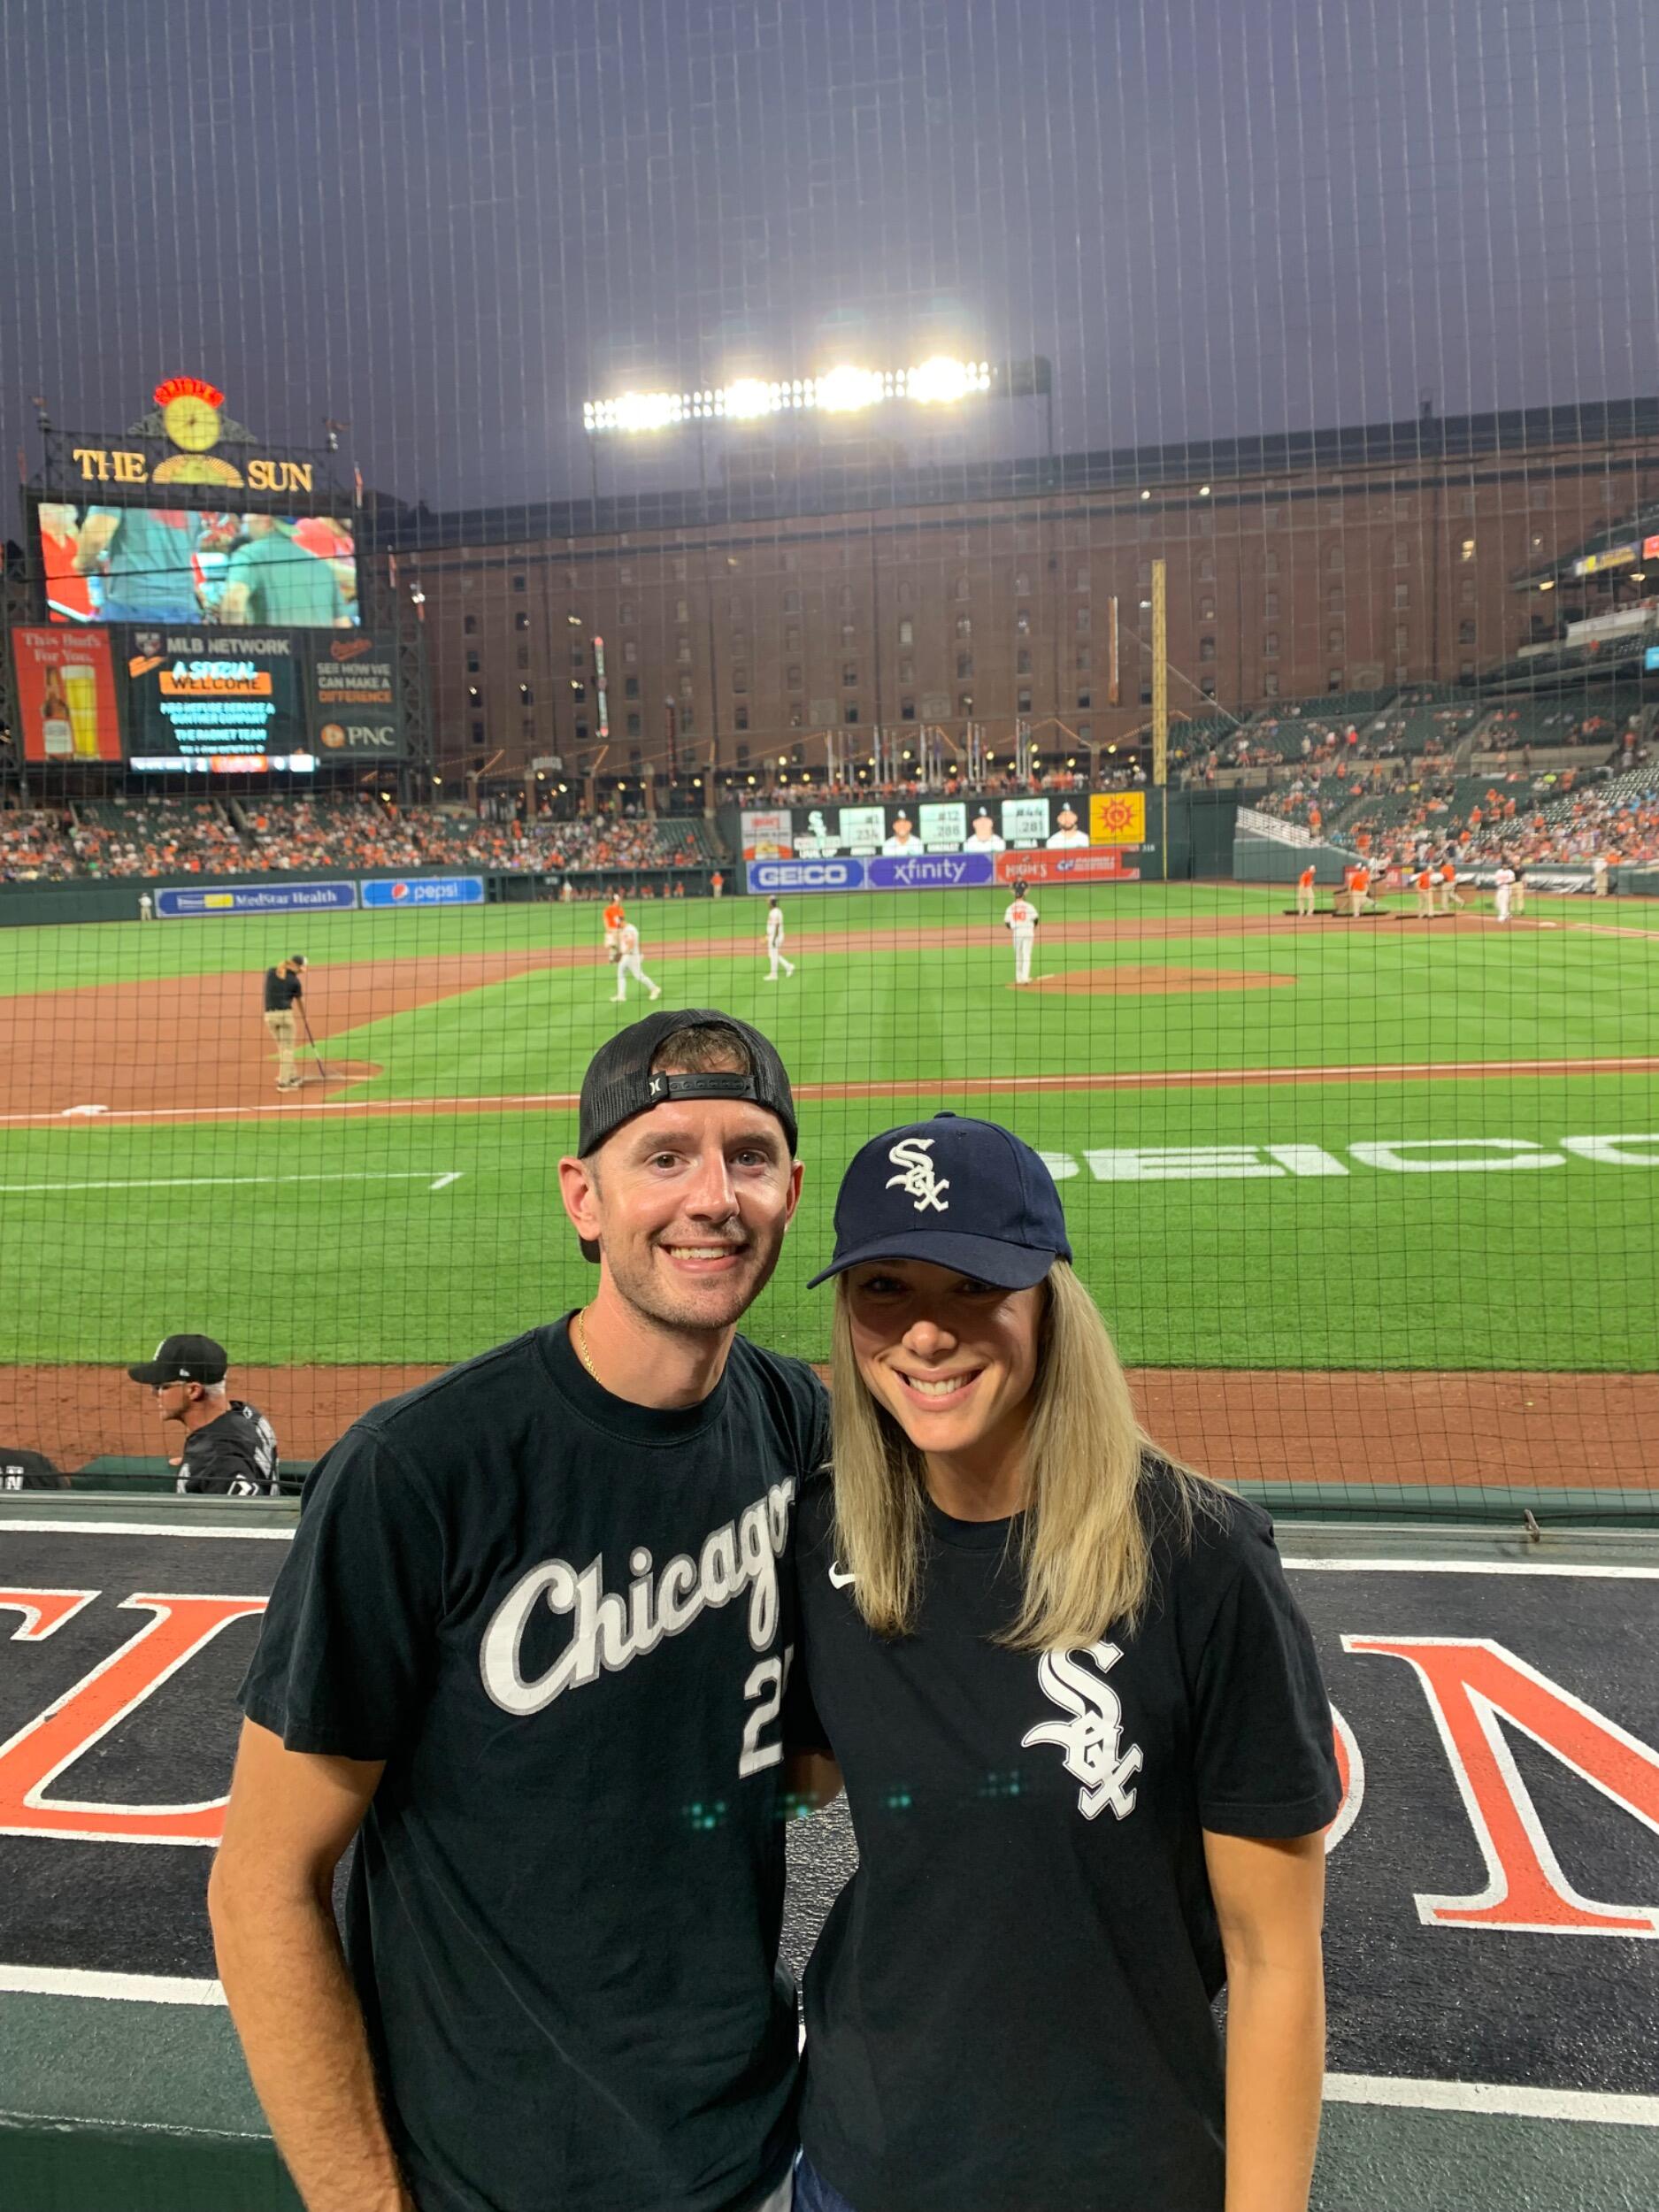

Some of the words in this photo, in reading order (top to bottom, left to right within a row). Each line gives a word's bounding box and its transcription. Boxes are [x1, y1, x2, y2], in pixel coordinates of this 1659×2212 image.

[73, 449, 149, 484] THE
[248, 459, 312, 493] SUN
[166, 637, 204, 654] MLB
[208, 638, 290, 656] NETWORK
[172, 675, 262, 690] WELCOME
[319, 676, 344, 688] CAN
[345, 676, 380, 688] MAKE
[347, 726, 396, 747] PNC
[758, 864, 848, 886] GEICO
[894, 858, 966, 884] xfinity
[234, 892, 290, 908] MedStar
[293, 889, 338, 905] Health
[414, 882, 458, 902] pepsi
[739, 1643, 794, 1779] 2
